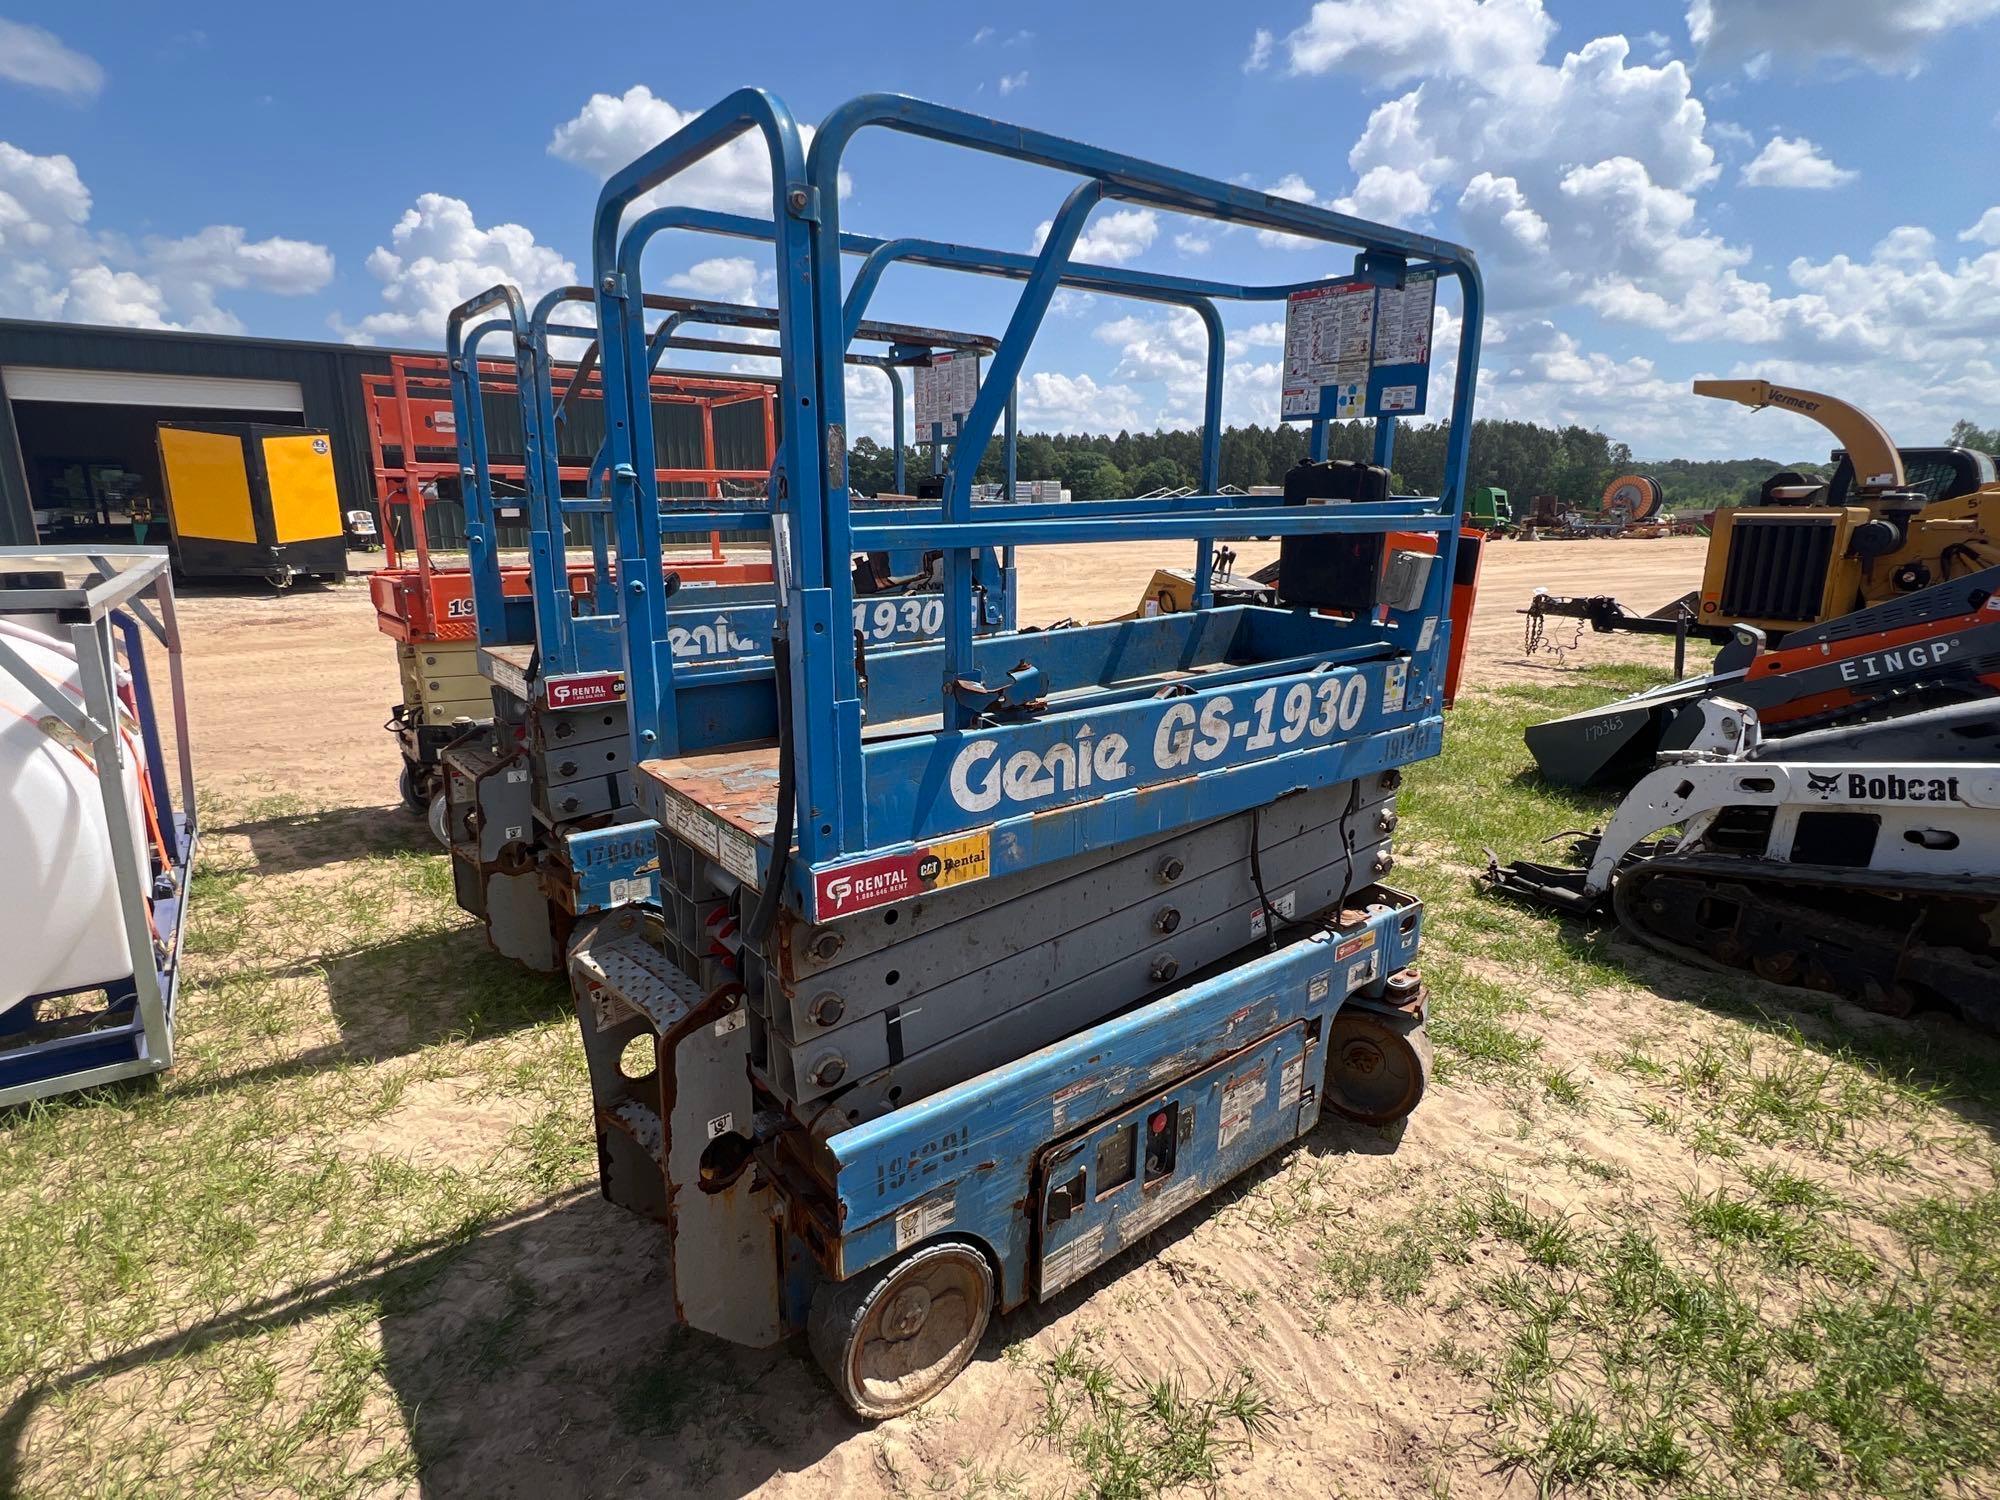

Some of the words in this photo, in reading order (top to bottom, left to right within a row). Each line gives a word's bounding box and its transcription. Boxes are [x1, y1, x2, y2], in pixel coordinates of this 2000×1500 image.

[1768, 389, 1820, 411] Vermeer
[1839, 642, 1949, 681] EINGP
[572, 685, 606, 696] RENTAL
[1153, 674, 1367, 769] GS-1930
[950, 723, 1129, 812] Genie
[1848, 773, 1959, 802] Bobcat
[920, 861, 938, 877] CAT
[943, 850, 986, 872] Rental
[855, 869, 908, 894] RENTAL
